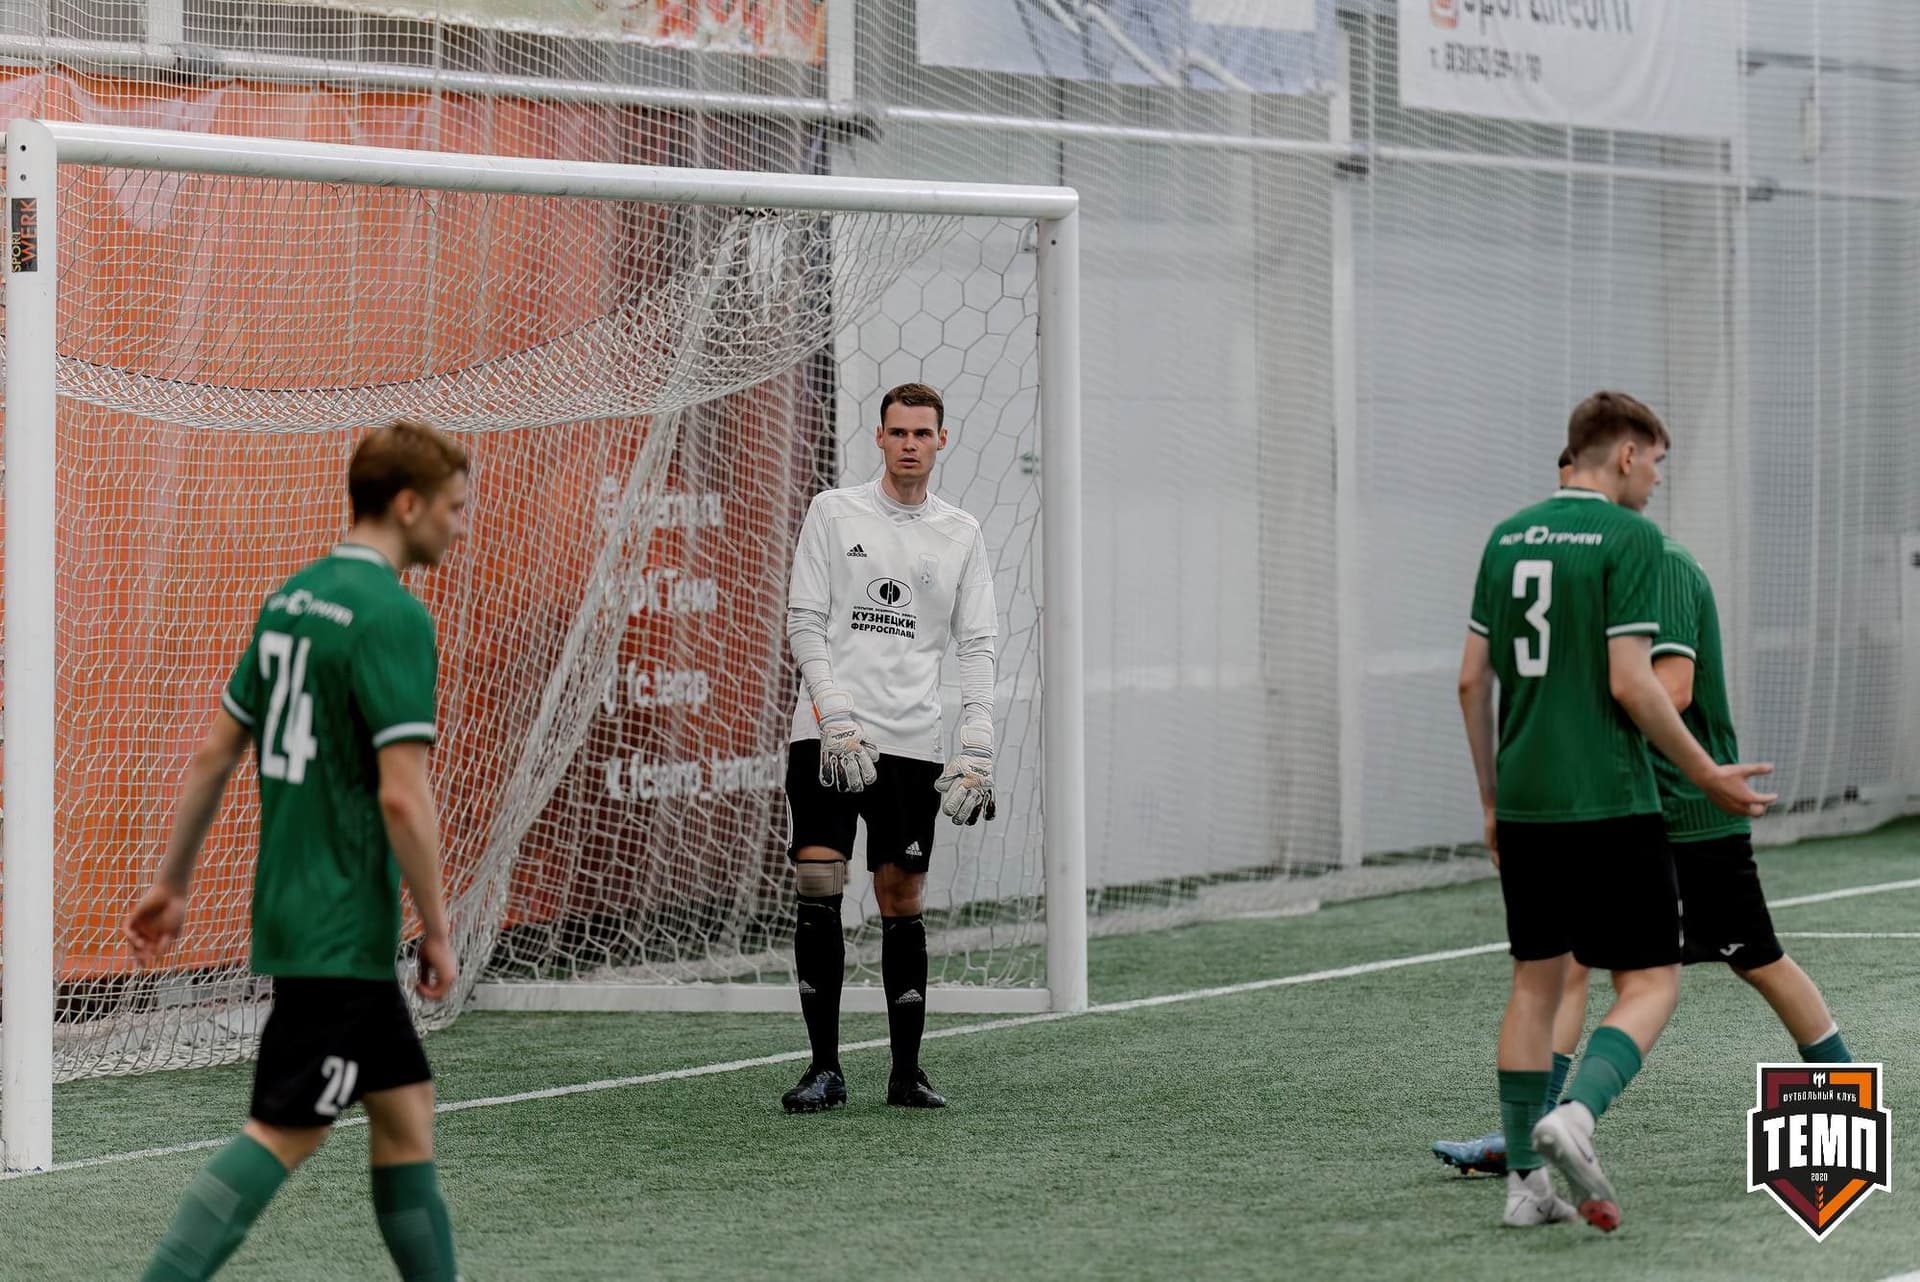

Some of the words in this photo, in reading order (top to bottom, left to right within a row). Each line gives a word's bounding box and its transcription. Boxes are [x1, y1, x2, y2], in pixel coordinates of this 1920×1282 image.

[20, 200, 37, 262] WERK
[1512, 559, 1553, 677] 3
[258, 629, 318, 785] 24
